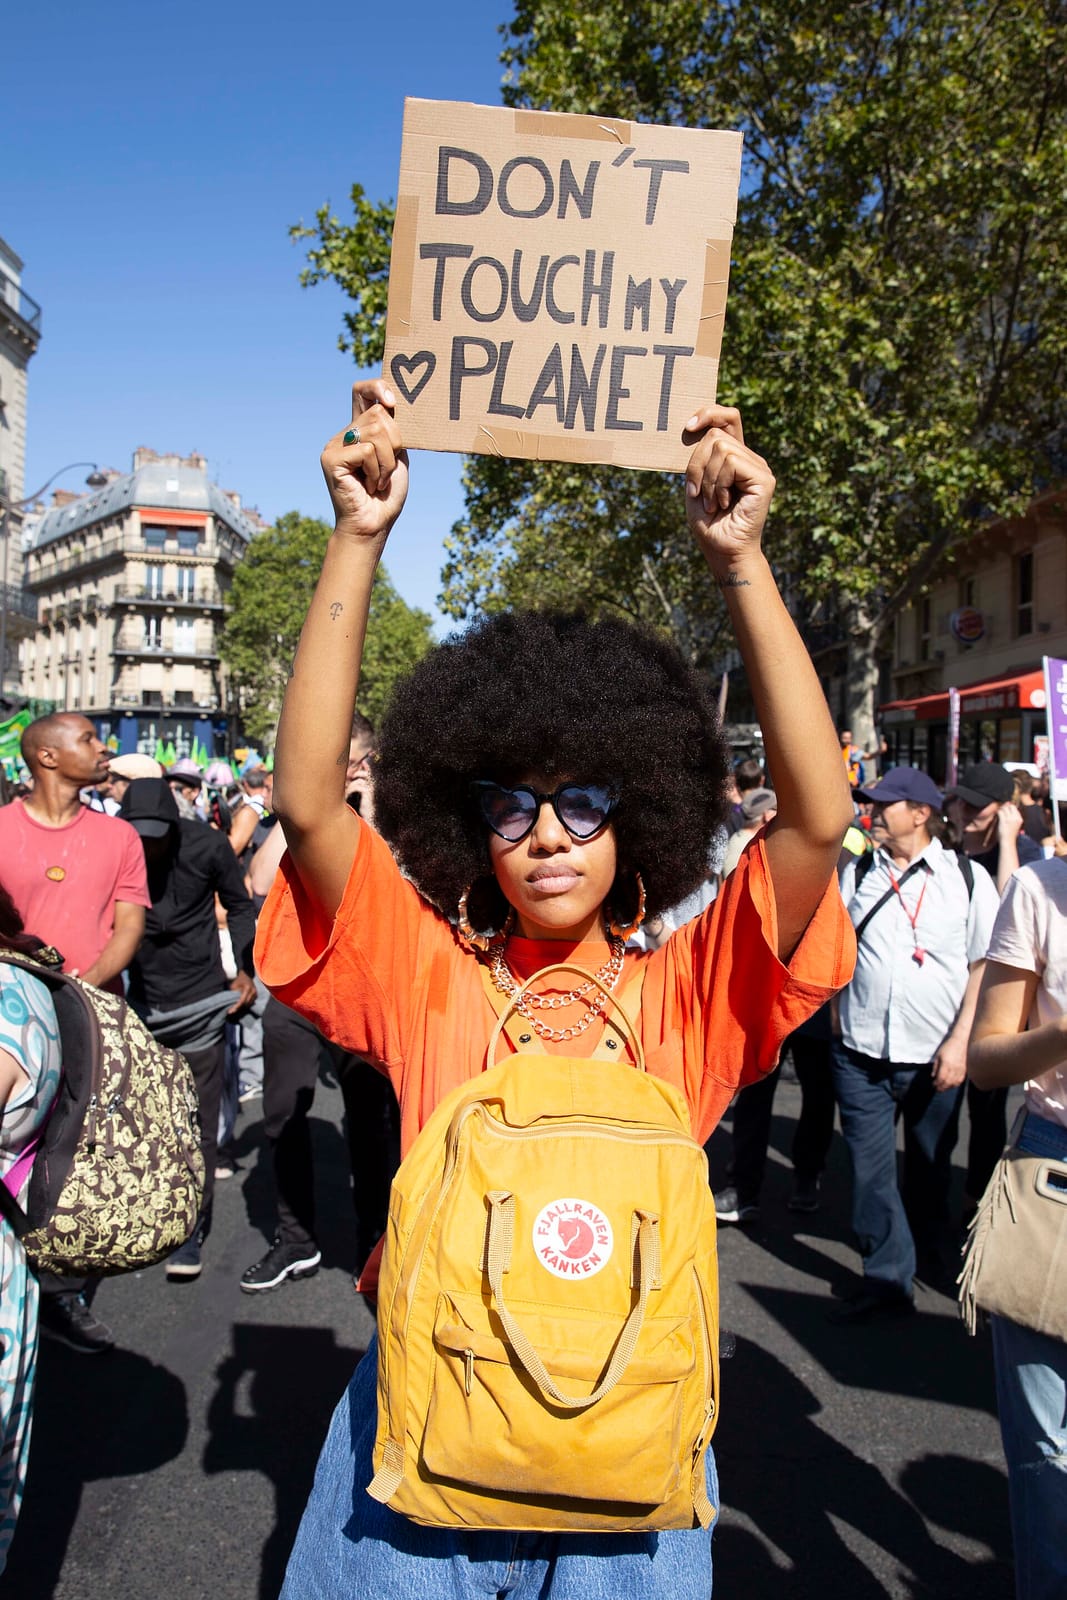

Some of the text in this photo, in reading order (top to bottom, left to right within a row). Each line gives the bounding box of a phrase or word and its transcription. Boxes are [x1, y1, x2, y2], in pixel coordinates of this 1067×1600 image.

[435, 146, 690, 225] DON'T
[419, 243, 688, 334] TOUCH MY
[449, 336, 695, 432] PLANET
[538, 1203, 608, 1245] FJALLRAVEN
[541, 1246, 601, 1274] KANKEN
